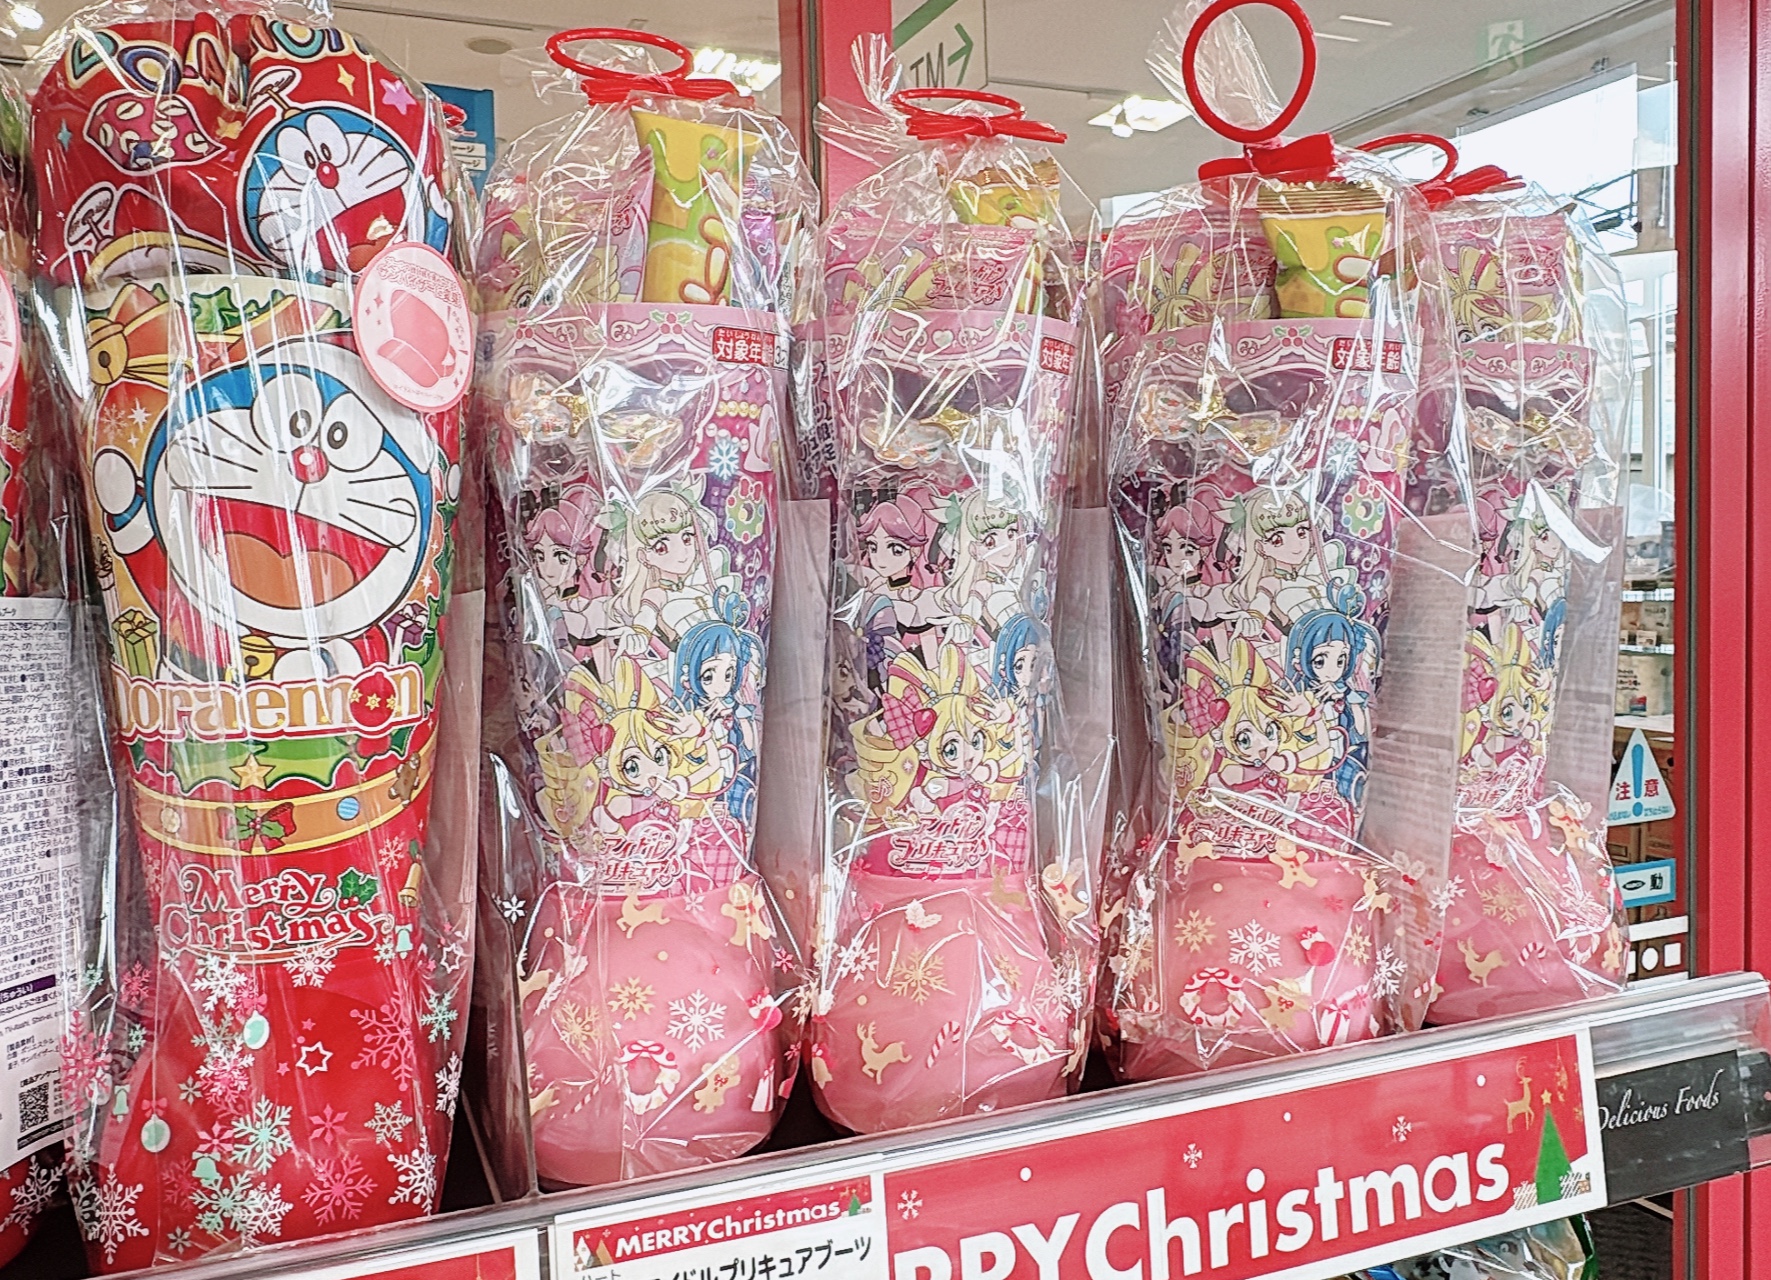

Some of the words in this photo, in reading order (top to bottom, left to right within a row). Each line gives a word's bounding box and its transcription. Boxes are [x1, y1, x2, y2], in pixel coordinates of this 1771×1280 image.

[181, 864, 335, 916] Merry
[161, 904, 388, 953] Christmas
[1674, 1068, 1725, 1115] Foods
[706, 1200, 841, 1240] Christmas
